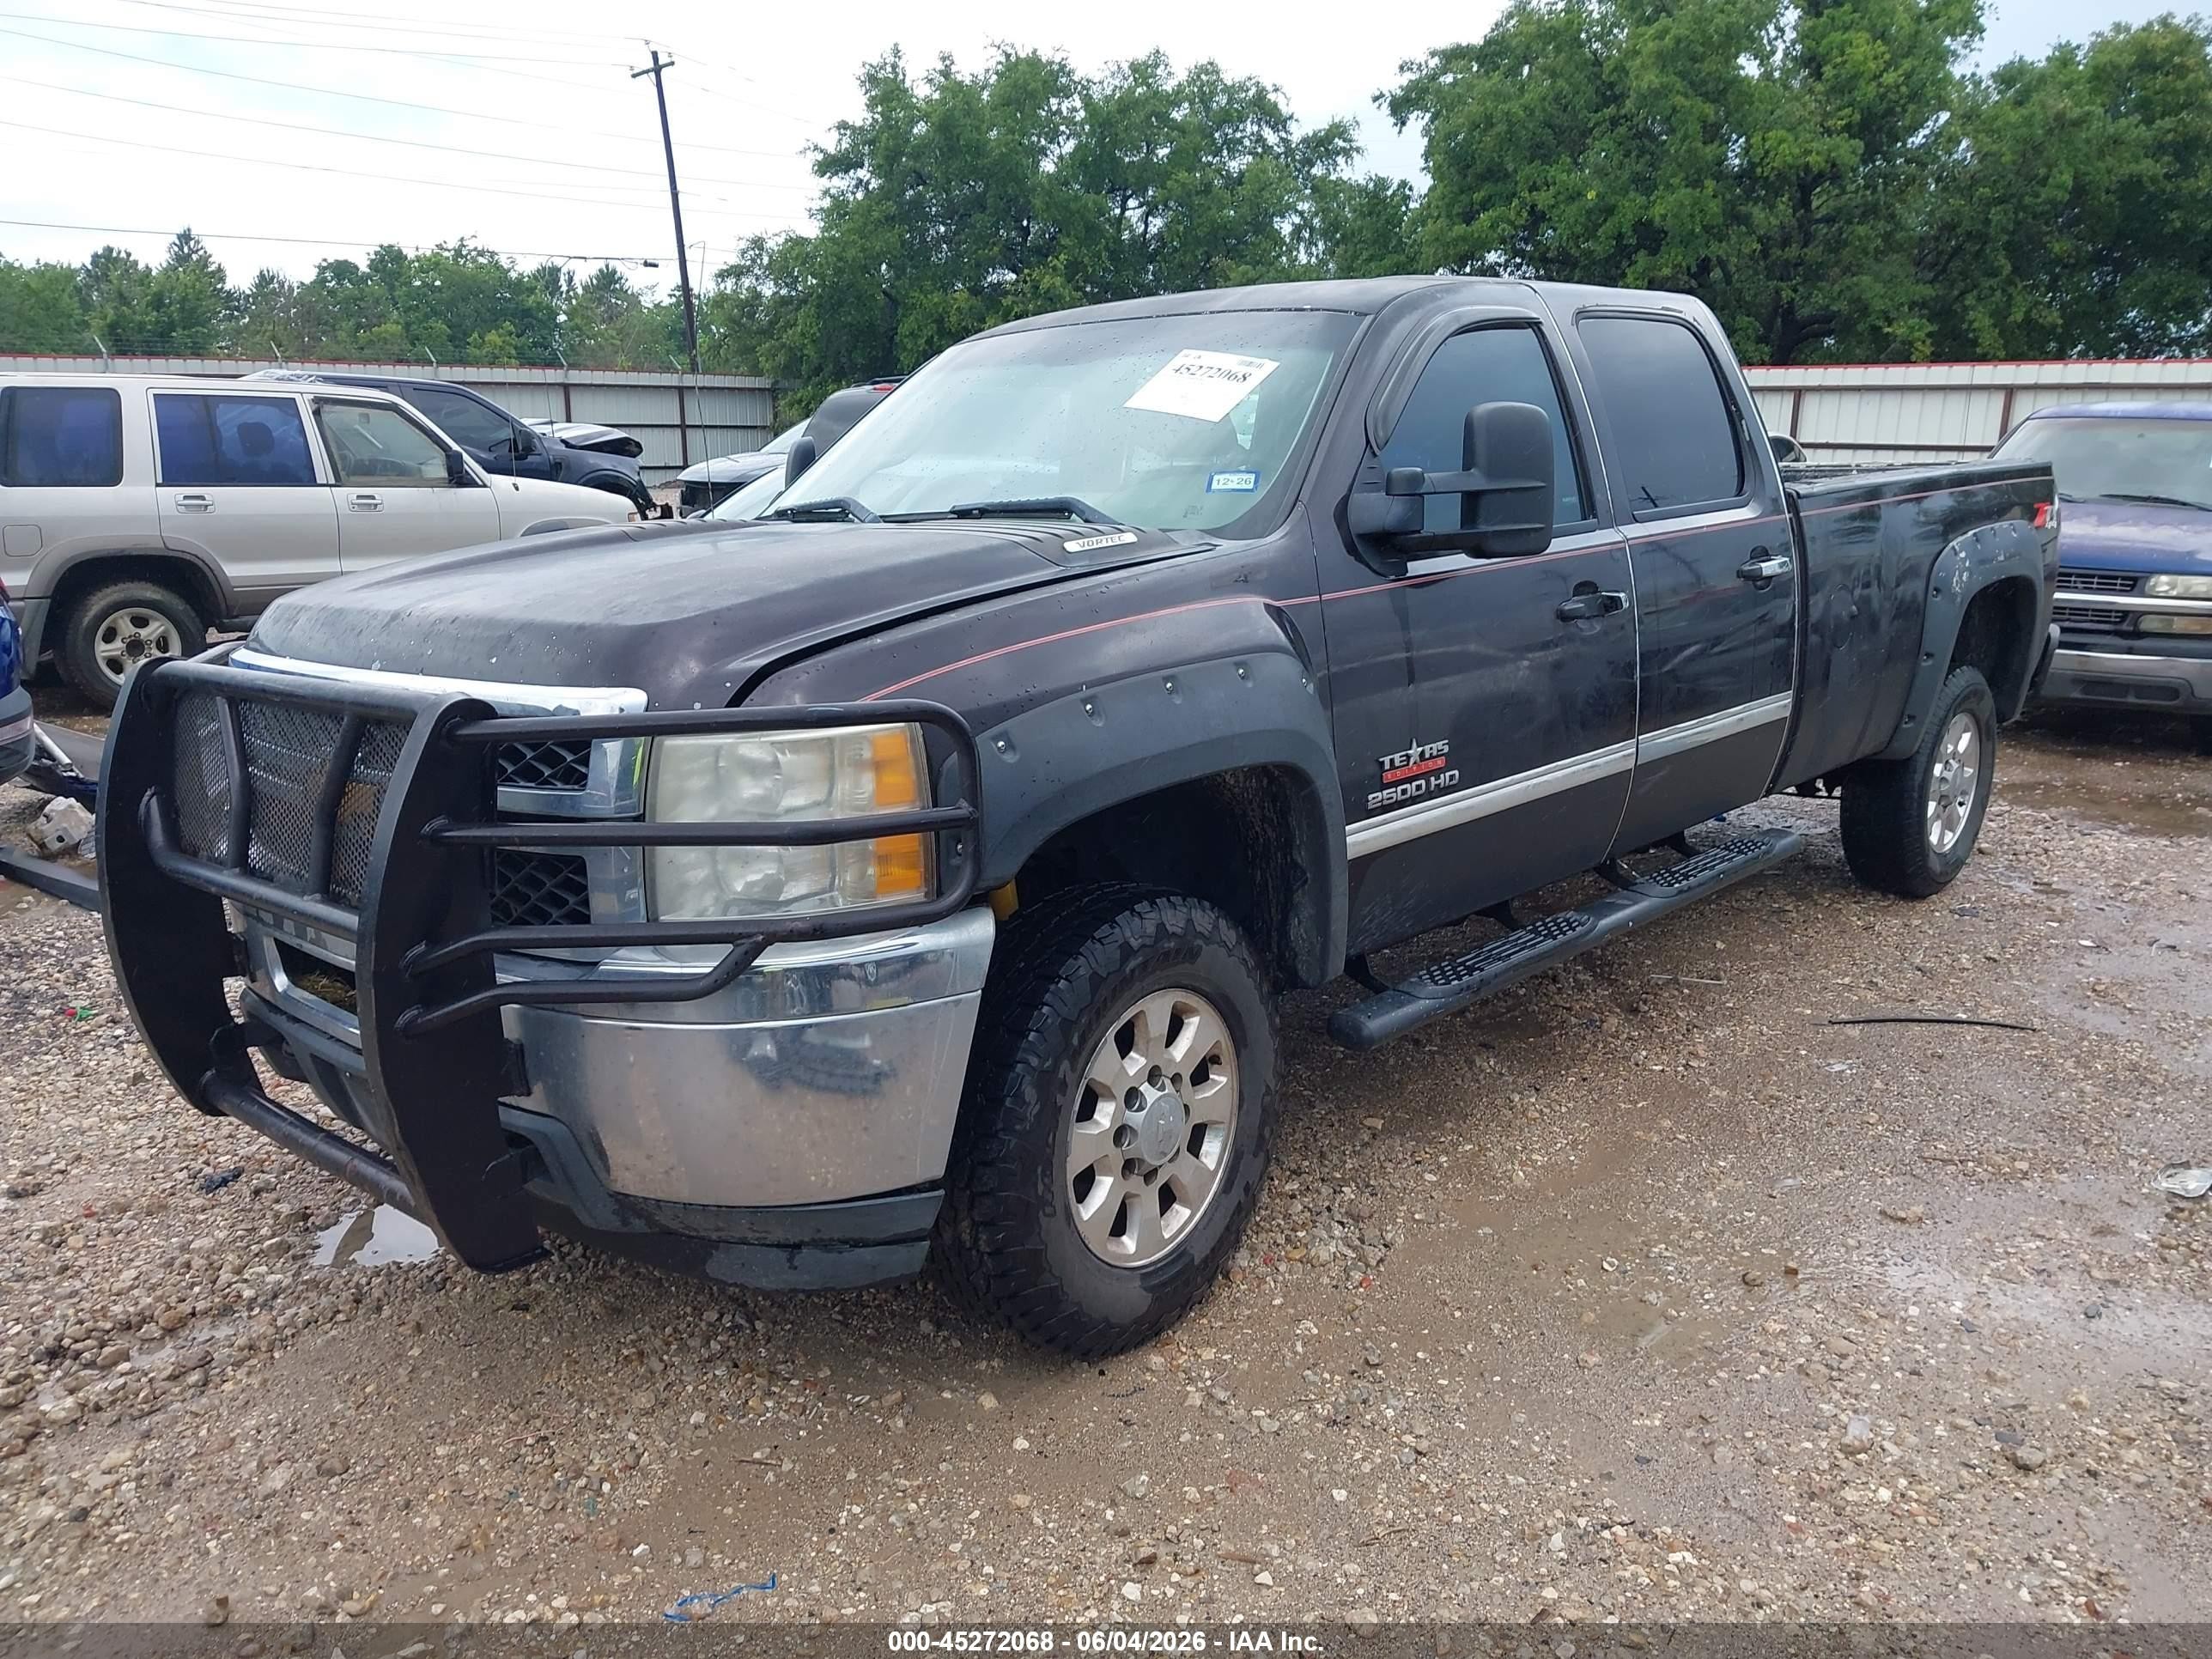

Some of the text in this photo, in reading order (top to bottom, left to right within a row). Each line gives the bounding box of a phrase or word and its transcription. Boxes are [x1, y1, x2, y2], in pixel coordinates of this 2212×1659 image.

[1172, 363, 1252, 384] 45272068
[1074, 534, 1126, 549] VORTEC
[1378, 738, 1449, 770] TEXAS
[1387, 760, 1443, 780] EDITION
[1367, 769, 1460, 811] 2500 HD
